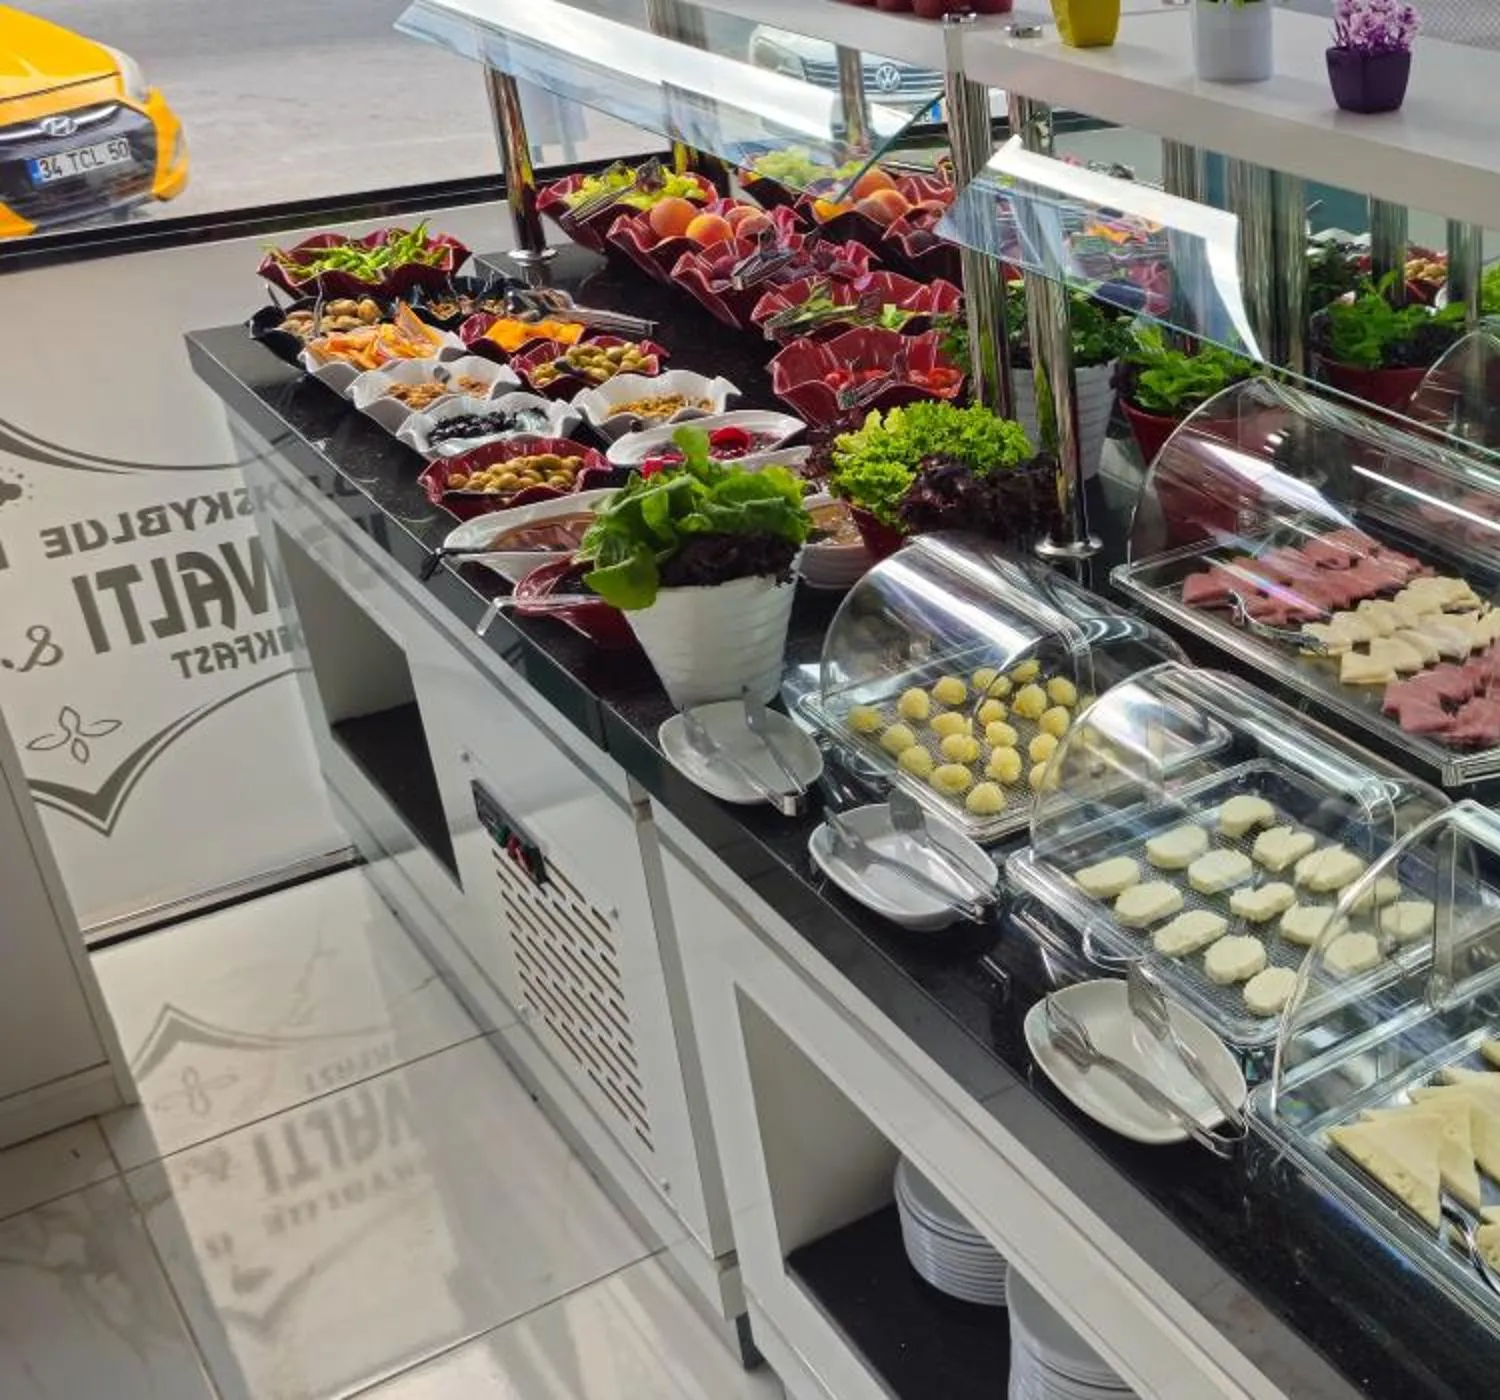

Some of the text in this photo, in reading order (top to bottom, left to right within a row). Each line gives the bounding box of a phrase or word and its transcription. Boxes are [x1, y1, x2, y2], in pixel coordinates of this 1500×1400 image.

[40, 140, 129, 179] 34 TCL 50
